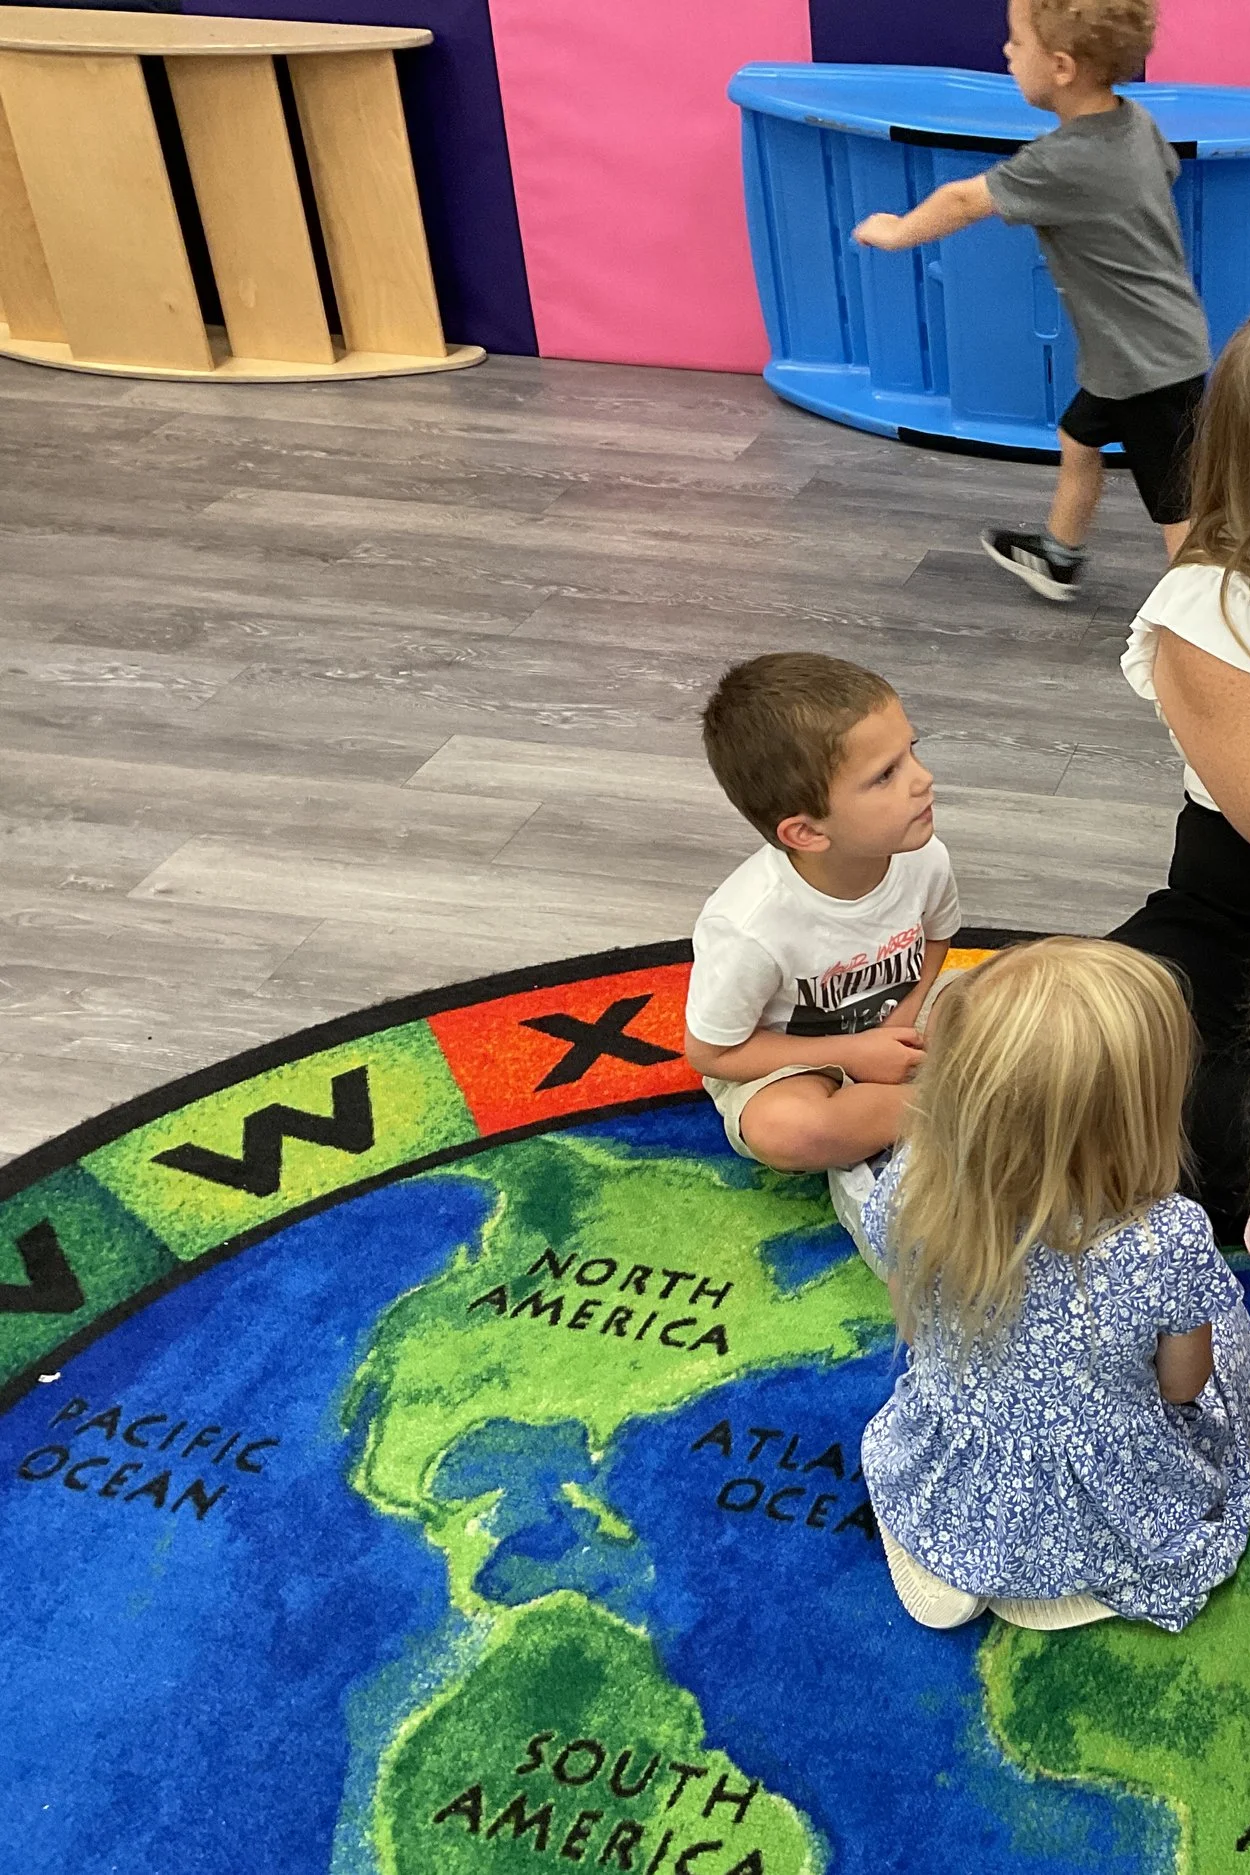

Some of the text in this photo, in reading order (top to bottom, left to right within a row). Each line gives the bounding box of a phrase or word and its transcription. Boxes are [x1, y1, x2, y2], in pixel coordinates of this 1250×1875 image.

[795, 936, 923, 1010] NIGHTMAR
[151, 1064, 375, 1197] W
[518, 993, 683, 1093] X
[527, 1247, 734, 1309] NORTH
[467, 1284, 730, 1355] AMERICA
[49, 1397, 281, 1474] PACIFIC
[690, 1419, 862, 1482] ATLA
[17, 1444, 229, 1520] OCEAN
[716, 1478, 878, 1541] OCEA
[515, 1731, 760, 1823] SOUTH
